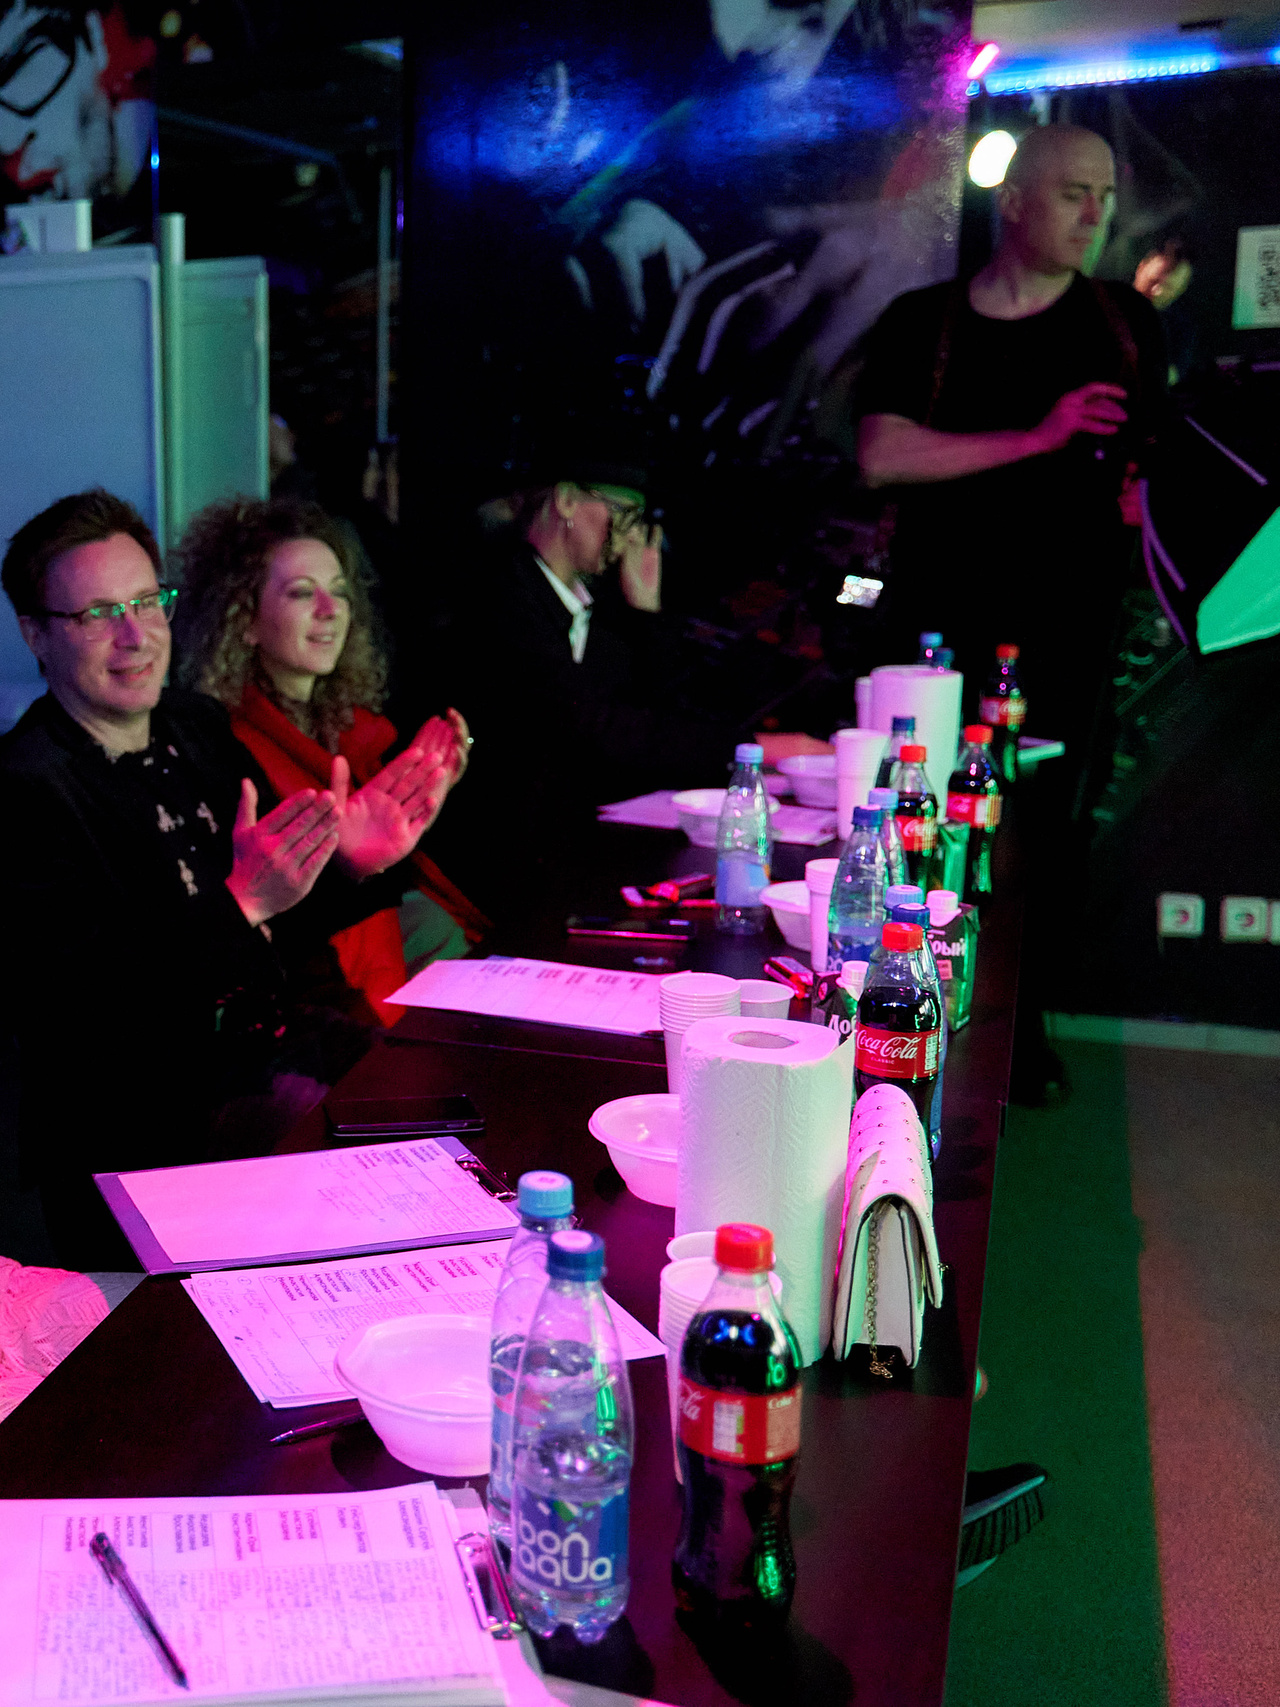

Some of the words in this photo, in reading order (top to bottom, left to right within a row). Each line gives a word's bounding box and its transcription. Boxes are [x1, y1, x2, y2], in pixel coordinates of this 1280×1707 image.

[857, 1030, 922, 1059] Coca-Cola
[870, 1056, 895, 1065] CLASSIC
[518, 1510, 590, 1558] bon
